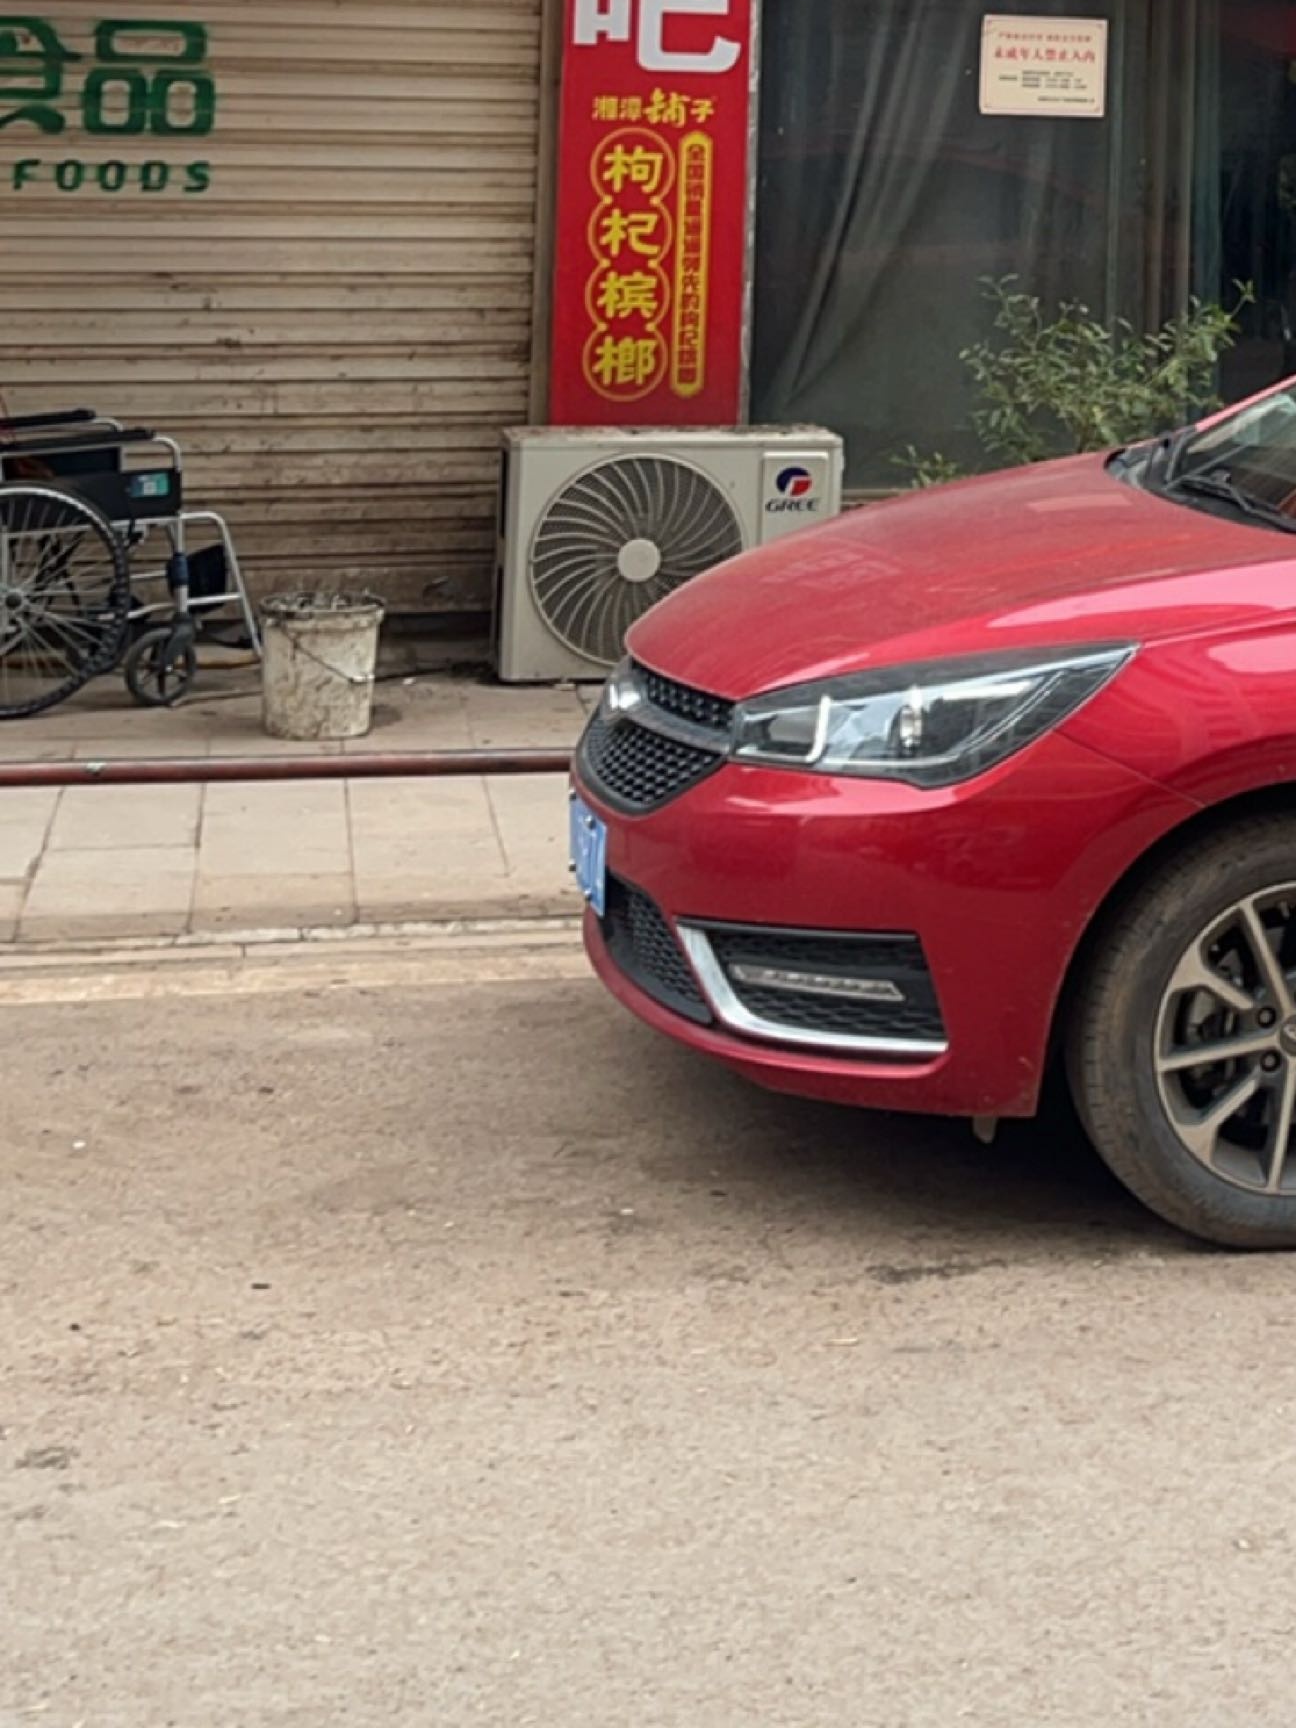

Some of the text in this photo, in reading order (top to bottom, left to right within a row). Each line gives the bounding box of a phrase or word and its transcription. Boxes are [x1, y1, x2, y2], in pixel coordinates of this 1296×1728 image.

[12, 158, 210, 192] FOODS
[592, 143, 664, 385] 枸杞槟榔
